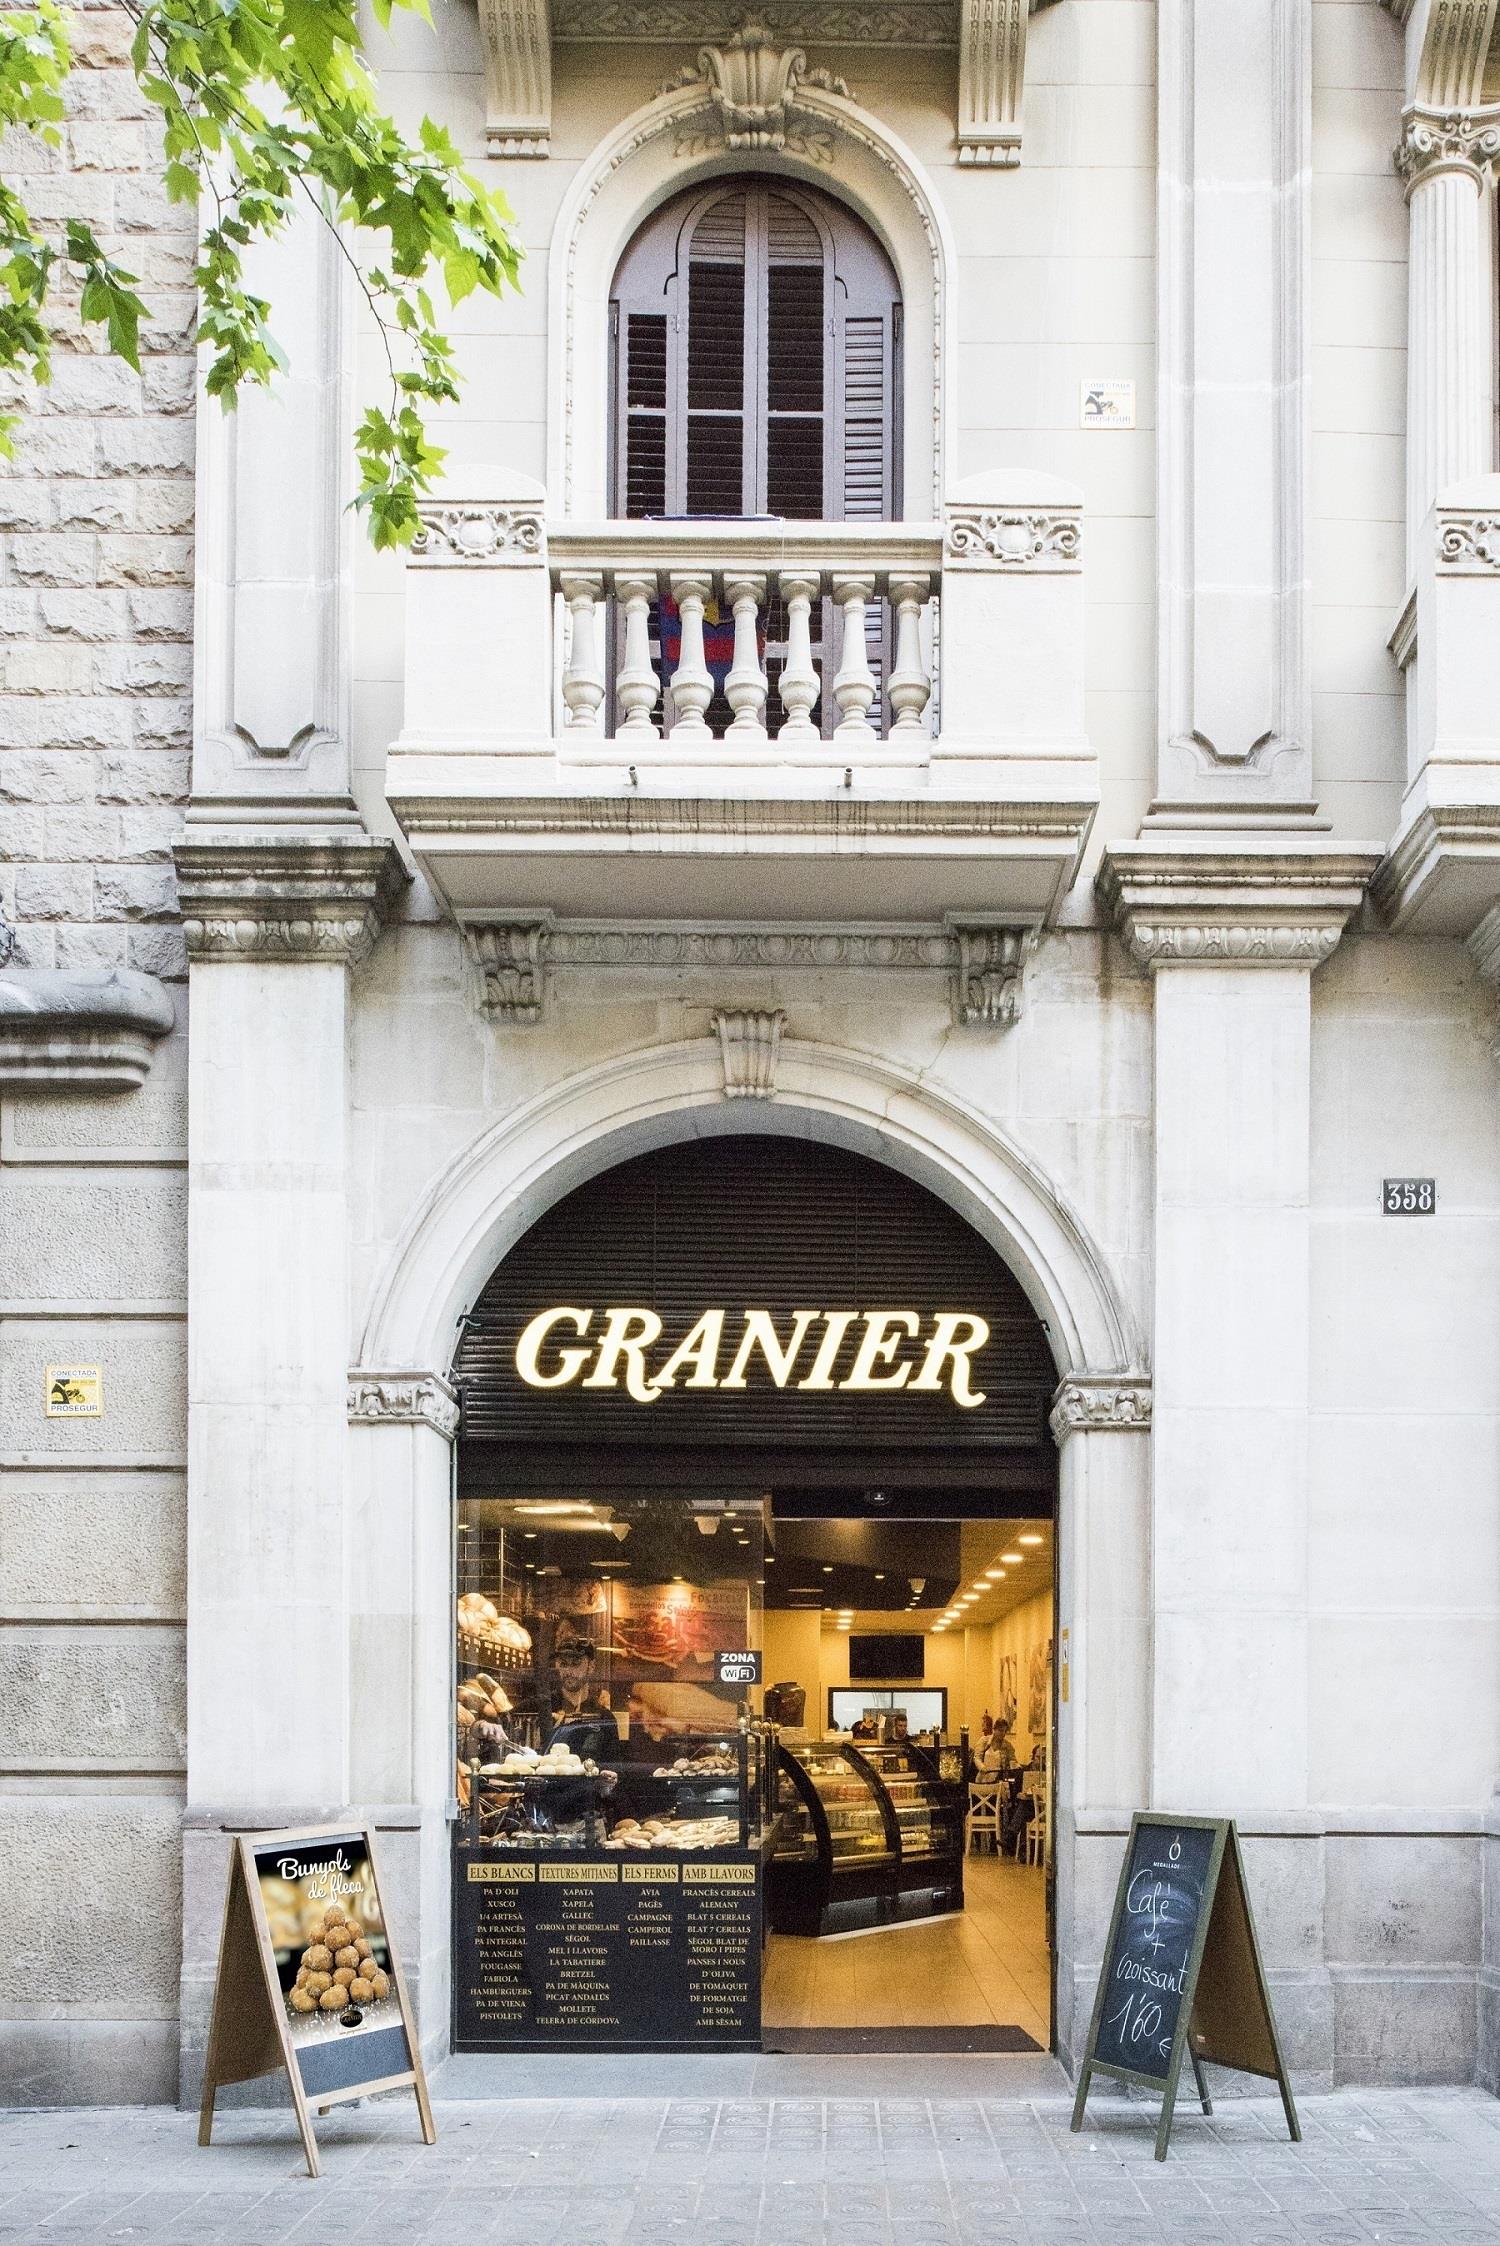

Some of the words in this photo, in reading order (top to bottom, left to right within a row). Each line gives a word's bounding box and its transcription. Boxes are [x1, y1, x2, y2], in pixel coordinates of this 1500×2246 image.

[1387, 1183, 1432, 1210] 358
[515, 1307, 990, 1408] GRANIER
[720, 1653, 756, 1663] ZONA
[276, 1848, 351, 1884] Bunyols
[470, 1867, 488, 1879] ELS
[491, 1867, 533, 1879] BLANCS
[541, 1867, 579, 1879] TEXTURES
[580, 1867, 617, 1881] MITJANES
[624, 1867, 641, 1879] ELS
[644, 1867, 677, 1879] FERMS
[684, 1868, 707, 1879] AMB
[710, 1868, 754, 1880] LLAVORS
[308, 1880, 327, 1899] de
[331, 1872, 364, 1903] fleca
[562, 1888, 594, 1896] XAPATA
[720, 1888, 756, 1897] CEREALS
[487, 1900, 516, 1908] XUSCO
[561, 1900, 594, 1908] XAPELA
[699, 1901, 740, 1909] ALEMANY
[1127, 1869, 1169, 1938] Café
[561, 1912, 594, 1920] GALLEC
[627, 1913, 674, 1921] CAMPAGNE
[687, 1913, 709, 1921] BLAT
[715, 1913, 751, 1921] CEREALS
[476, 1925, 488, 1933] PA
[535, 1923, 566, 1931] CORONA
[566, 1923, 577, 1931] DE
[577, 1923, 621, 1931] BORDELAISE
[627, 1926, 673, 1934] CAMPEROL
[687, 1925, 708, 1934] BLAT
[715, 1925, 751, 1934] CEREALS
[629, 1938, 671, 1946] PAILLASSE
[479, 1950, 490, 1958] PA
[572, 1947, 609, 1955] LLAVORS
[549, 1958, 561, 1966] LA
[687, 1958, 716, 1966] PANSES
[722, 1958, 746, 1966] NOUS
[560, 1970, 596, 1978] BRETZEL
[483, 1975, 519, 1983] FABIOLA
[545, 1982, 556, 1991] PA
[557, 1982, 569, 1991] DE
[570, 1981, 610, 1991] MÀQUINA
[689, 1982, 701, 1991] DE
[470, 1988, 533, 1996] HAMBURGUERS
[545, 1993, 570, 2001] PICAT
[475, 2000, 486, 2008] PA
[487, 2000, 500, 2008] DE
[500, 2000, 527, 2008] VIENA
[558, 2005, 597, 2013] MOLLETE
[702, 2006, 715, 2014] DE
[715, 2006, 735, 2014] SOJA
[479, 2012, 523, 2020] PISTOLETS
[535, 2016, 566, 2024] TELERA
[567, 2016, 579, 2024] DE
[695, 2018, 715, 2026] AMB
